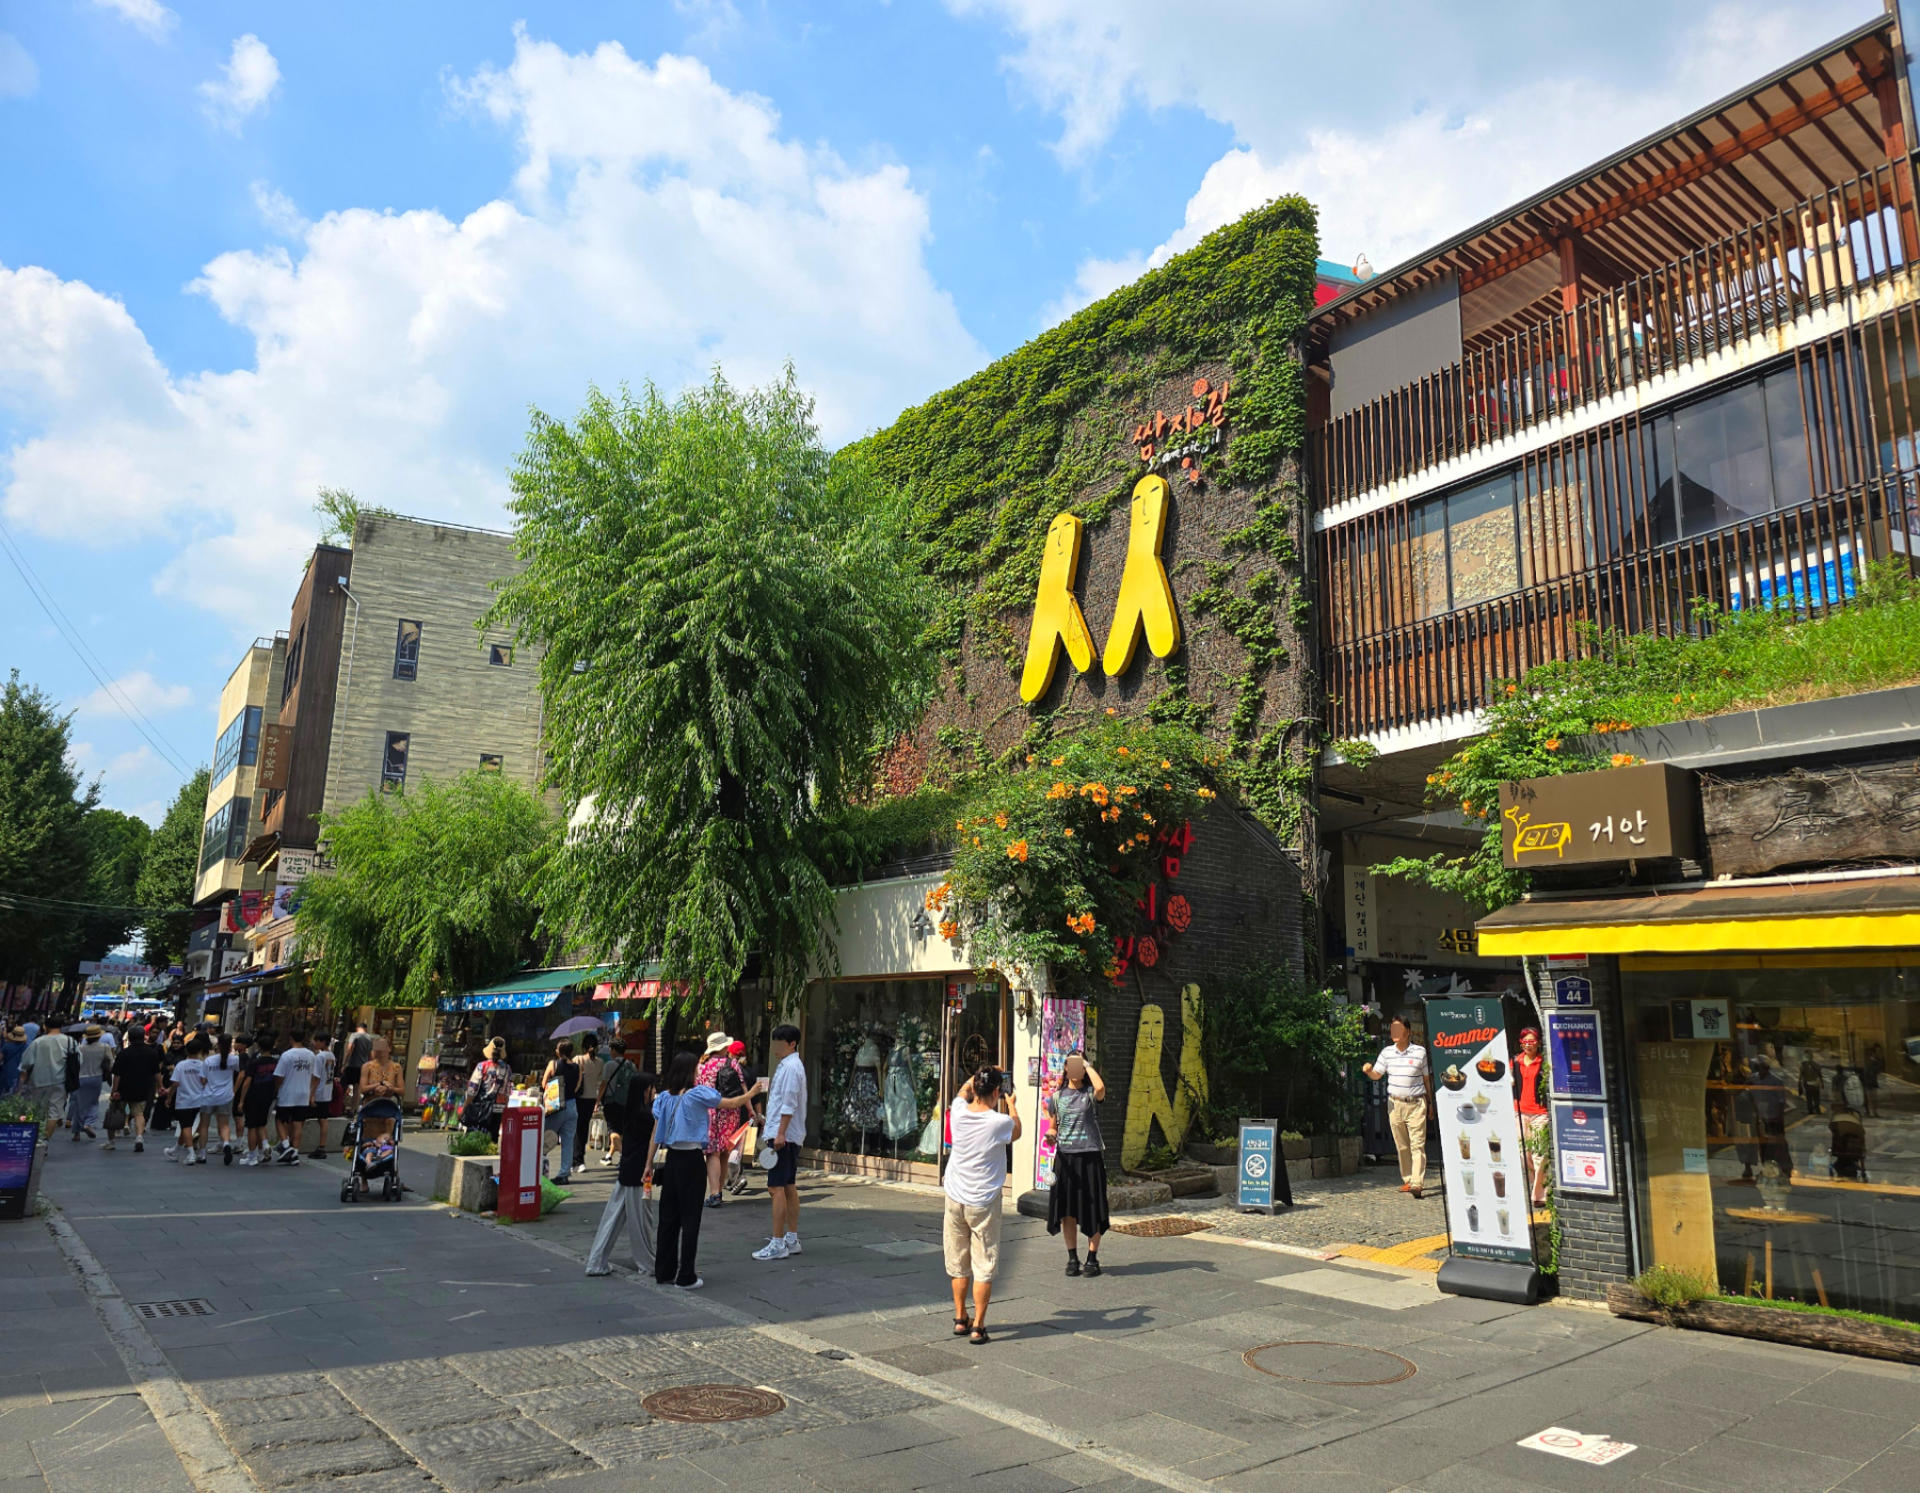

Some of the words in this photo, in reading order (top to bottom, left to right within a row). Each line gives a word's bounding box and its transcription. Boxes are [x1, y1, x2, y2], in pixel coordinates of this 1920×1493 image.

[1589, 810, 1648, 845] 거안
[1566, 990, 1583, 1002] 44
[1433, 1026, 1498, 1048] Summer
